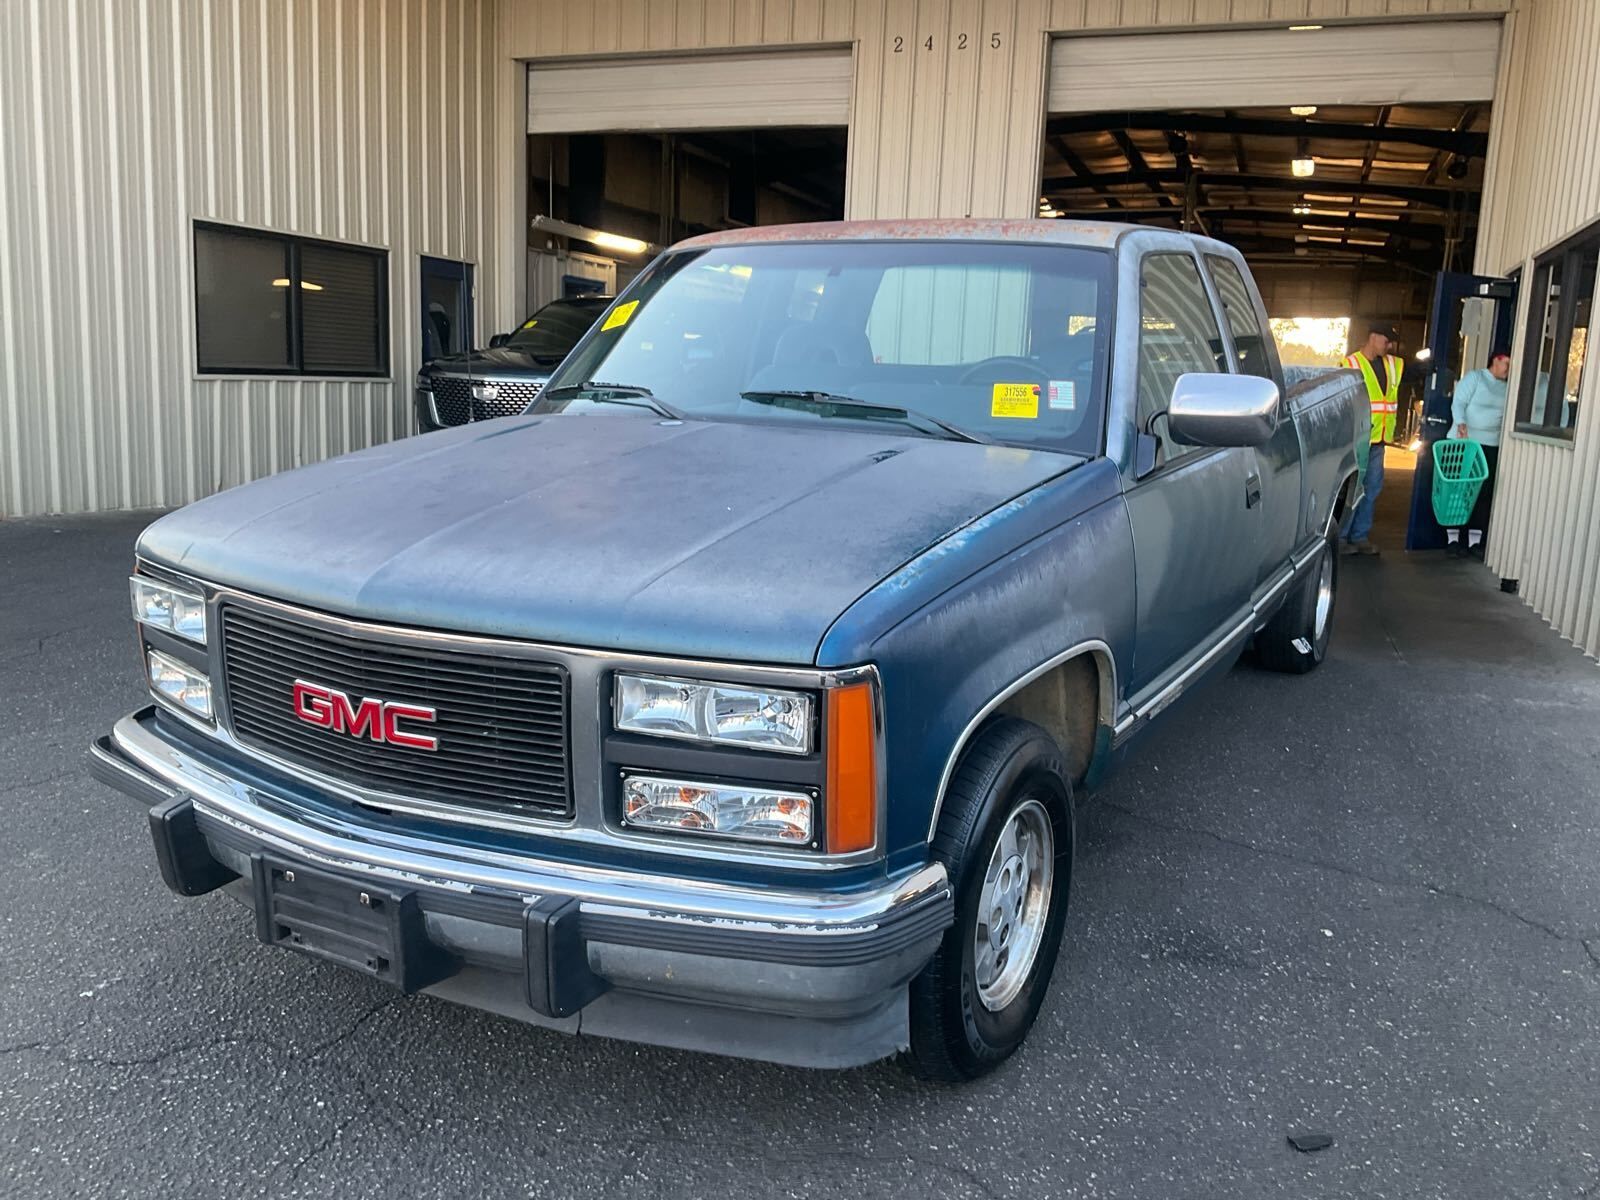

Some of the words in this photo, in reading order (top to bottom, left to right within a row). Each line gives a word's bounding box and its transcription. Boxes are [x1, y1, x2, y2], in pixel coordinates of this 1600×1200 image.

[893, 32, 1001, 53] 2425
[1004, 386, 1027, 397] 317556
[293, 678, 438, 751] GMC
